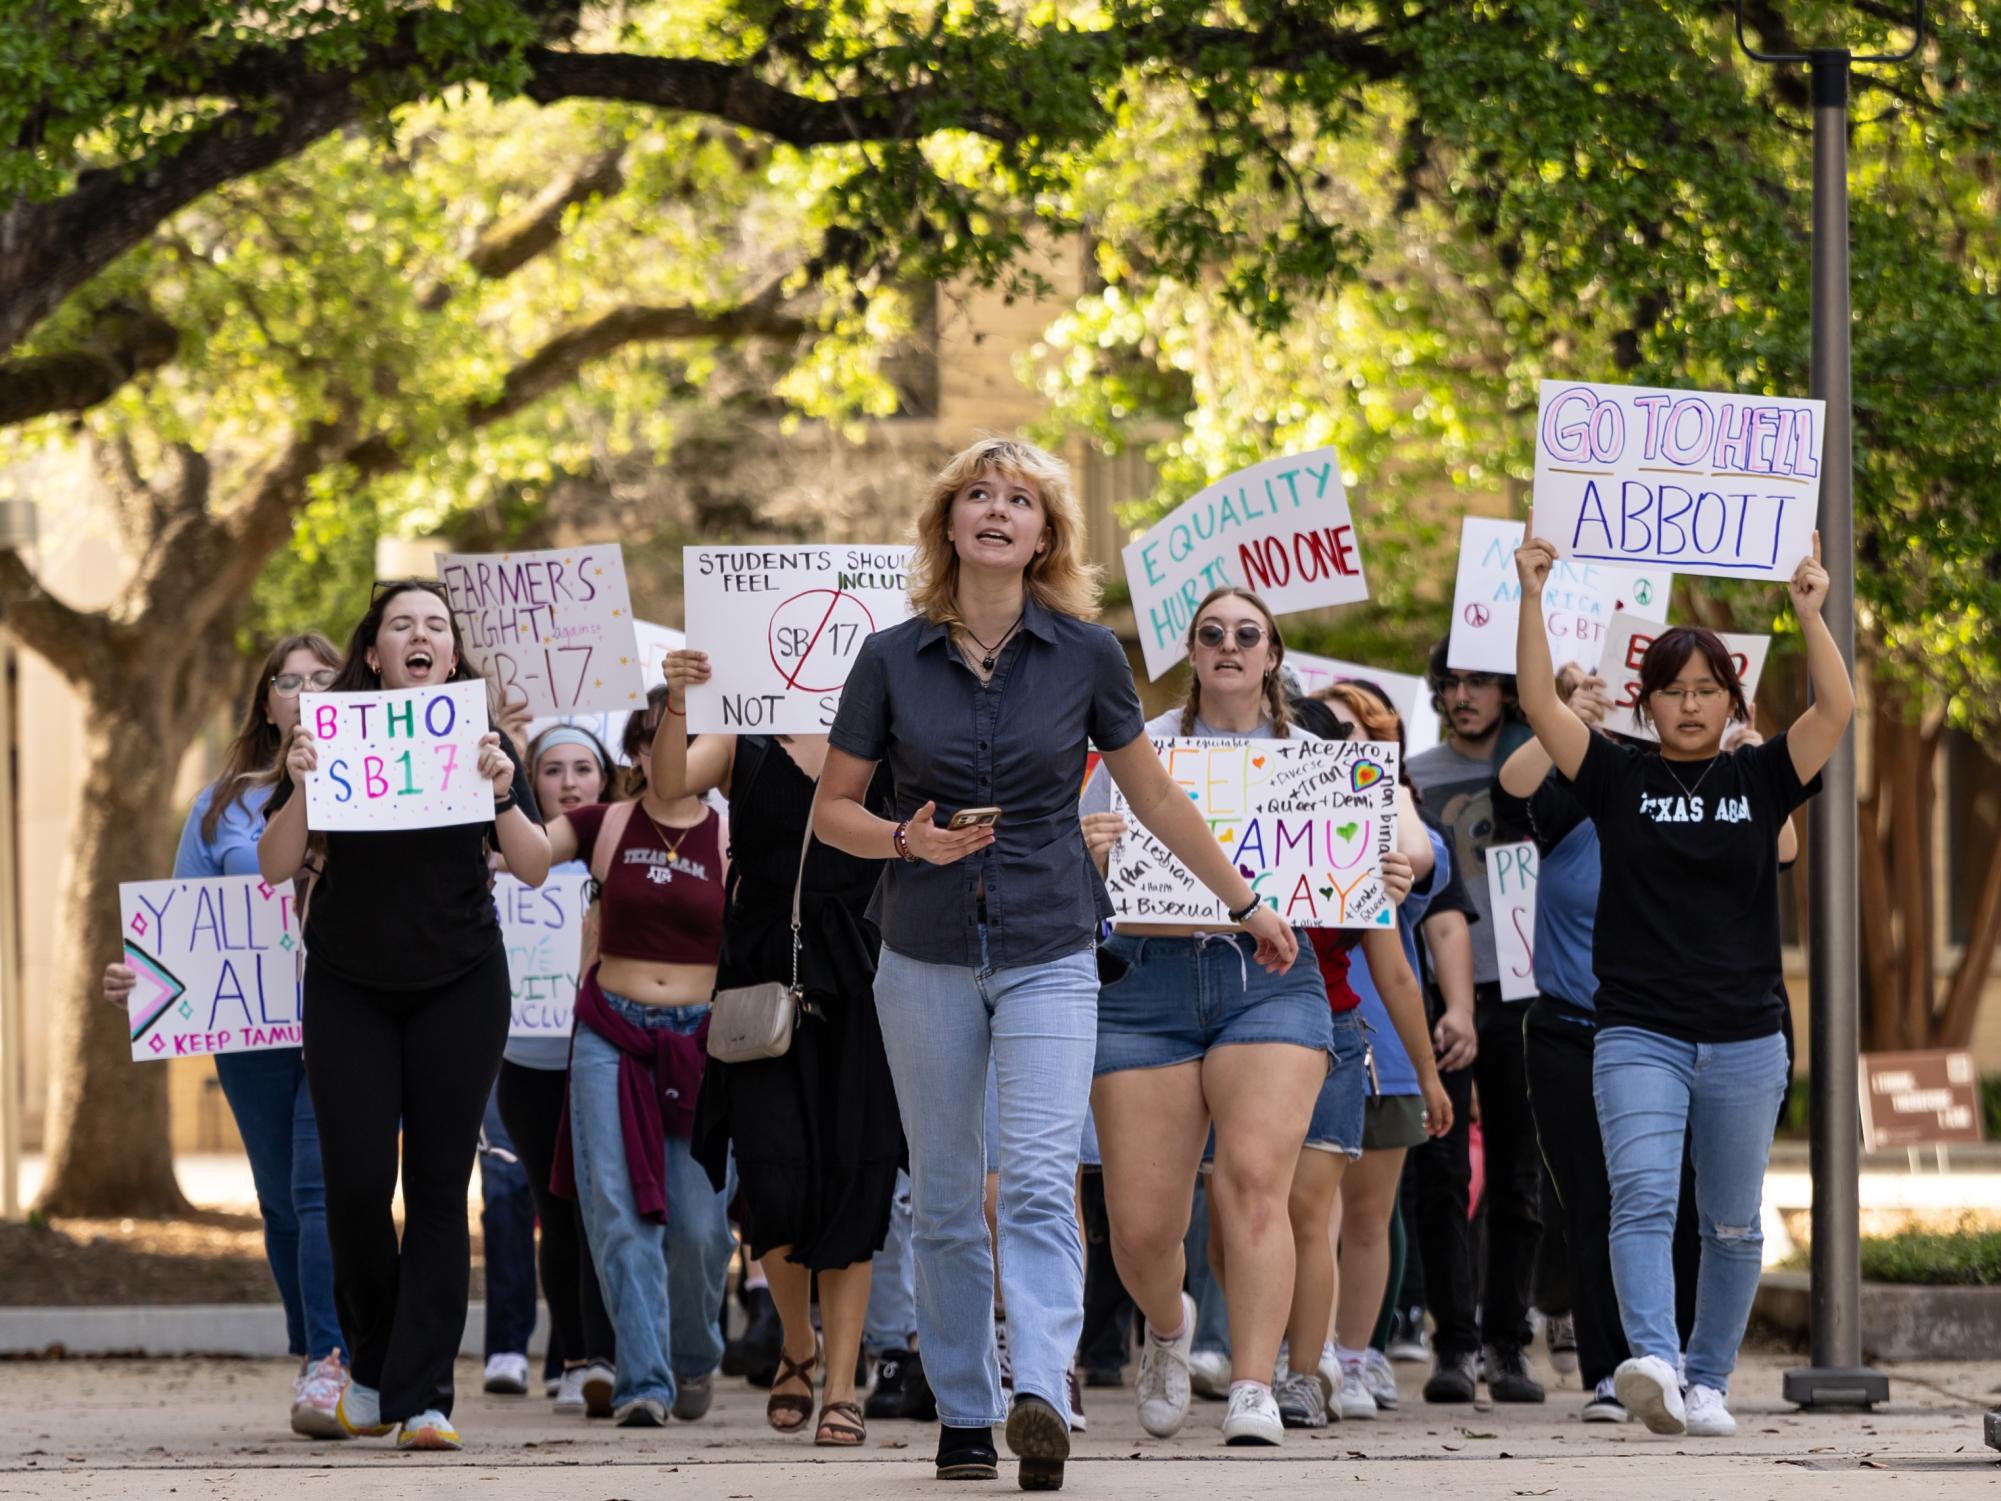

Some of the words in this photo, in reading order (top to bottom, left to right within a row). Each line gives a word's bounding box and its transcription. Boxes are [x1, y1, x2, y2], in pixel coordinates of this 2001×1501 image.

[1542, 387, 1625, 464] GO
[1634, 397, 1714, 466] TO
[1712, 404, 1818, 478] HELL
[1141, 462, 1331, 587] EQUALITY
[1572, 480, 1796, 565] ABBOTT
[699, 550, 832, 575] STUDENTS
[723, 574, 780, 593] FEEL
[838, 571, 908, 591] INCLUD
[1237, 535, 1291, 593] NO
[1292, 524, 1360, 583] ONE
[1482, 537, 1600, 591] MKE
[443, 555, 597, 611] FARMERS
[1492, 580, 1602, 616] AMRICA
[776, 626, 811, 658] SB
[827, 623, 859, 657] 17
[1547, 612, 1606, 641] GBT
[315, 694, 456, 741] BTHO
[722, 694, 785, 727] NOT
[328, 743, 459, 804] SB17
[1298, 739, 1381, 762] Ace/Aro
[1167, 744, 1276, 817] EEP
[137, 884, 269, 956] Y'ALL
[1137, 898, 1222, 921] Bisexual
[173, 1034, 231, 1055] KEEP
[239, 1026, 302, 1047] TAMU
